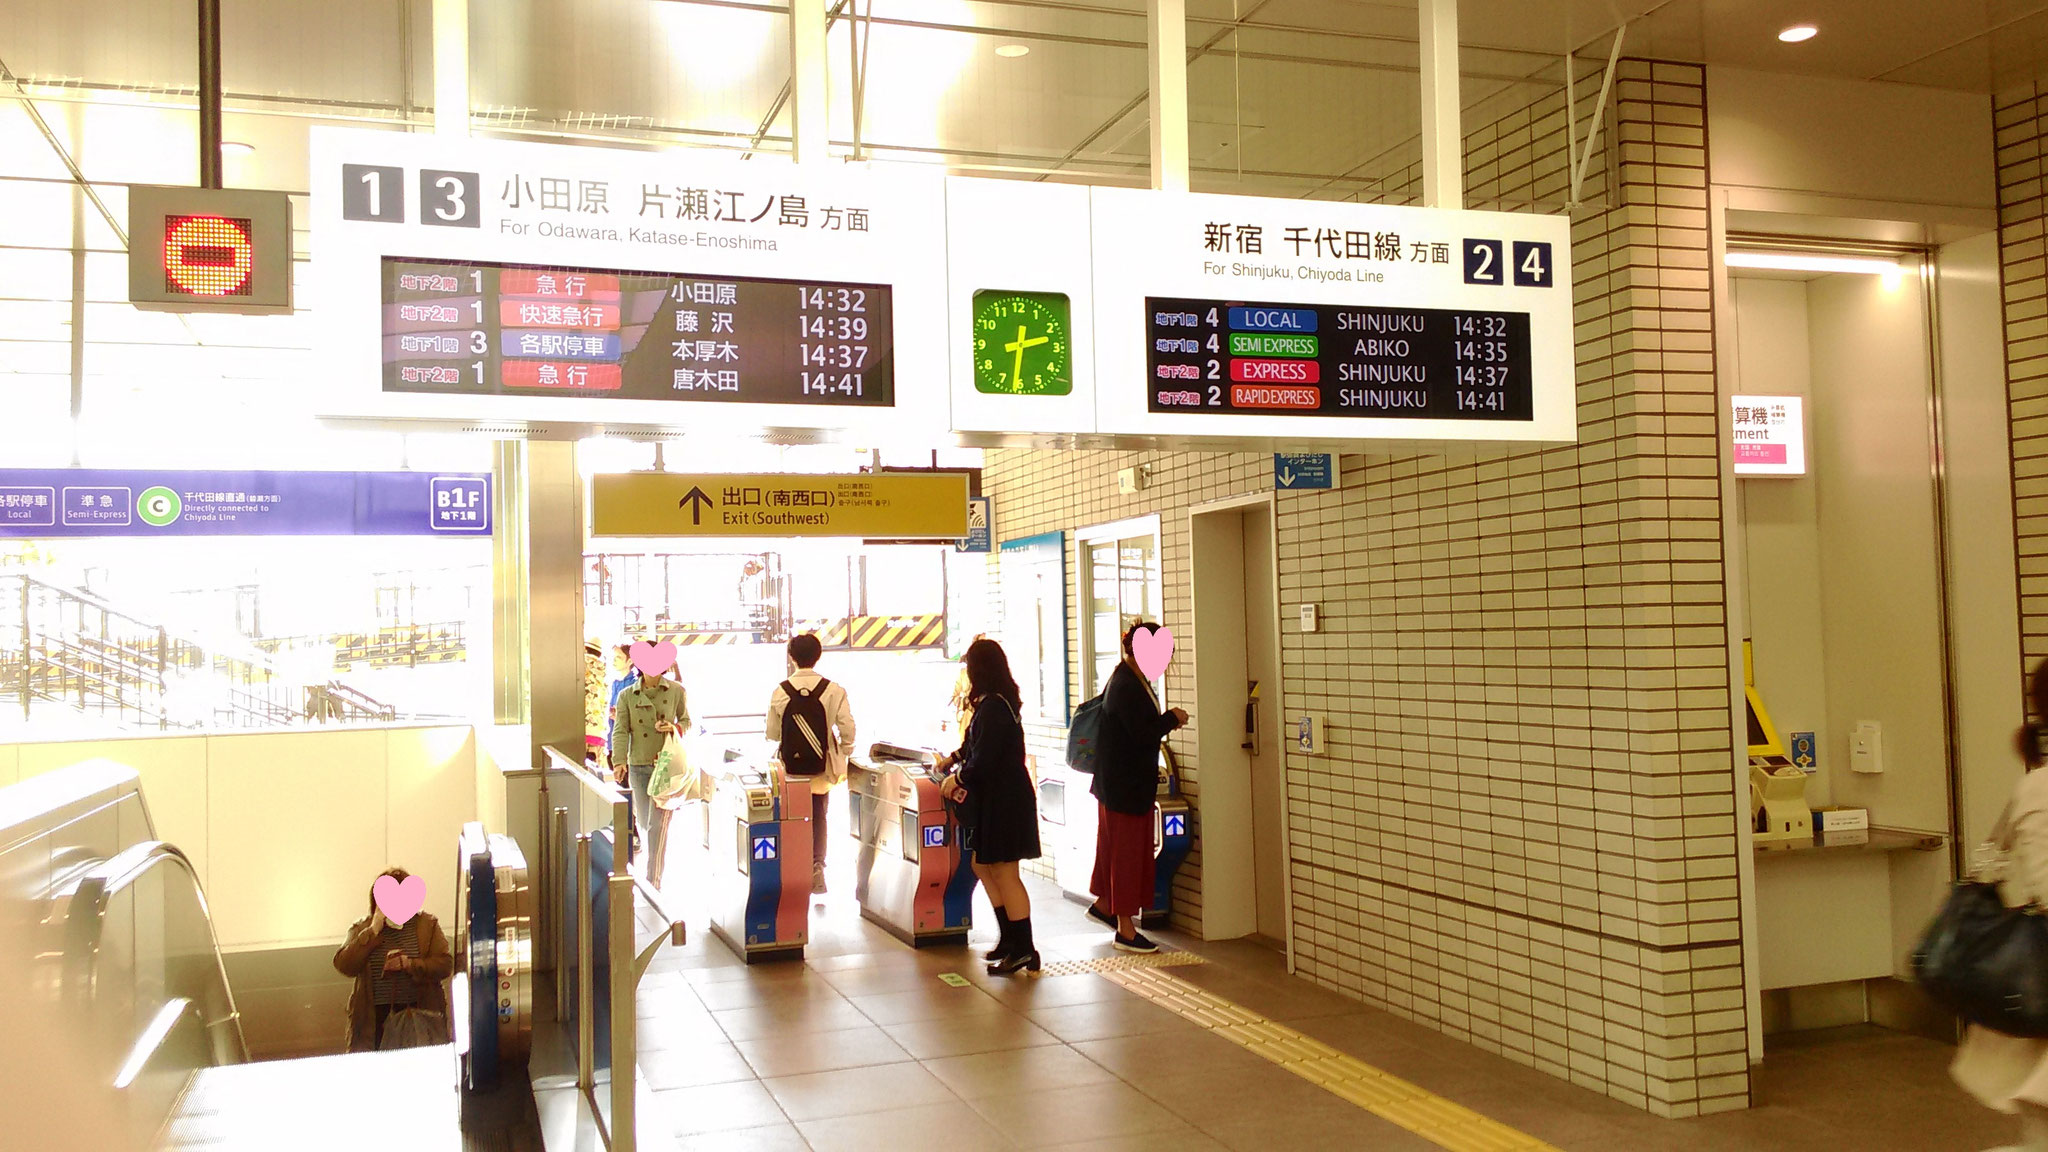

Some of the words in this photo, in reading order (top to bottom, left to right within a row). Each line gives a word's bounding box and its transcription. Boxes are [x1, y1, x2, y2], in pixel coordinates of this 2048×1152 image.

[361, 171, 381, 216] 1
[435, 176, 466, 221] 3
[501, 173, 609, 214] 小田原
[638, 184, 809, 228] 片瀬江ノ島
[820, 205, 869, 232] 方面
[500, 219, 530, 235] For
[538, 221, 623, 243] Odawara,
[629, 227, 778, 252] Katase-Enoshima
[1204, 221, 1263, 255] 新宿
[1284, 227, 1401, 262] 千代田線
[1410, 241, 1449, 264] 方面
[1472, 244, 1494, 280] 2
[1521, 247, 1545, 282] 4
[401, 274, 458, 293] 地下2階
[470, 270, 482, 293] 1
[1204, 262, 1226, 275] For
[1232, 262, 1294, 280] Shinjuku,
[1297, 266, 1352, 283] Chiyoda
[1356, 269, 1384, 283] Line
[671, 280, 737, 305] 小田原
[799, 287, 866, 313] 14:32
[401, 305, 458, 323] 地下2階
[470, 300, 482, 323] 1
[519, 303, 604, 328] 快速急行
[994, 307, 1007, 317] 11
[1012, 302, 1025, 313] 12
[1033, 309, 1039, 320] 1
[1155, 312, 1198, 327] 地下1階
[1205, 307, 1219, 328] 4
[800, 315, 868, 341] 14:39
[982, 320, 996, 330] 10
[1046, 323, 1054, 333] 2
[1245, 311, 1302, 329] LOCAL
[1337, 312, 1424, 334] SHINJUKU
[1454, 316, 1507, 337] 14:32
[402, 335, 459, 353] 地下1階
[470, 331, 487, 355] 3
[520, 333, 604, 357] 各駅停車
[978, 339, 986, 350] 9
[1053, 342, 1060, 353] 3
[1156, 338, 1199, 353] 地下1階
[1206, 333, 1220, 353] 4
[1233, 336, 1261, 352] SEMI
[1264, 338, 1315, 355] EXPRESS
[1354, 338, 1410, 357] ABIKO
[1454, 340, 1508, 362] 14:35
[672, 339, 739, 363] 本厚木
[800, 343, 868, 368] 14:37
[402, 367, 459, 384] 地下2階
[471, 361, 483, 385] 1
[984, 359, 993, 370] 8
[1047, 362, 1055, 372] 4
[1157, 364, 1200, 380] 地下2階
[1207, 359, 1220, 379] 2
[1243, 362, 1307, 380] EXPRESS
[673, 368, 739, 392] 唐木田
[801, 371, 862, 396] 14:41
[999, 372, 1007, 383] 7
[1034, 375, 1042, 385] 5
[1338, 363, 1426, 385] SHINJUKU
[1455, 365, 1509, 387] 14:37
[1158, 390, 1201, 405] 地下2階
[1208, 385, 1221, 405] 2
[1339, 388, 1427, 410] SHINJUKU
[1456, 390, 1505, 411] 14:41
[1733, 406, 1768, 425] 算機
[1733, 428, 1769, 440] ment
[152, 499, 164, 513] C
[437, 487, 480, 508] B1F
[8, 510, 32, 519] Local
[67, 509, 127, 519] Semi-Express
[184, 504, 216, 513] Directly
[218, 504, 258, 512] connected
[261, 504, 270, 512] to
[184, 514, 217, 523] Chiyoda
[440, 510, 477, 521] 地下1階
[722, 511, 749, 525] Exit
[752, 511, 830, 526] (Southwest)
[926, 829, 943, 845] IC
